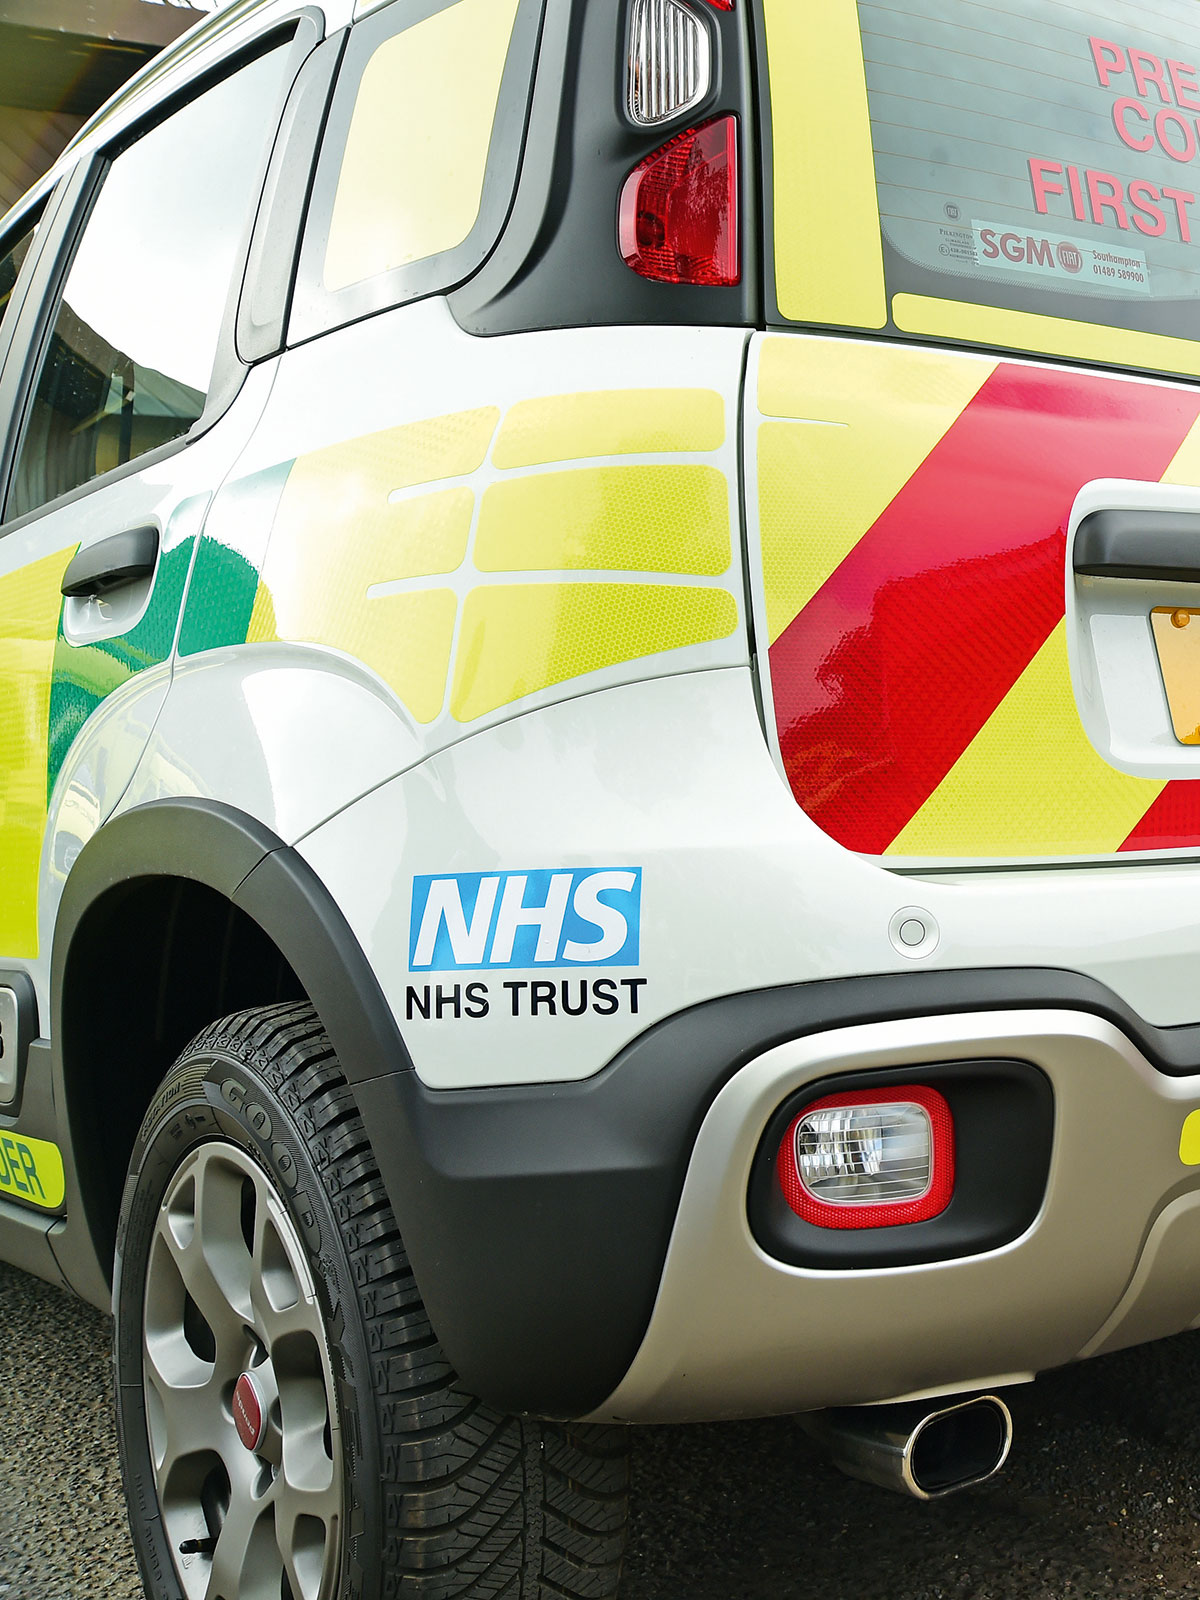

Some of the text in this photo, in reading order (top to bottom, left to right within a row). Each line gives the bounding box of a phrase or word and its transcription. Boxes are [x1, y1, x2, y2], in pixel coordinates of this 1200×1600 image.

[1028, 158, 1195, 243] FIRST
[980, 229, 1056, 269] SGM
[1061, 250, 1078, 266] FIAT
[1092, 249, 1141, 268] Southampton
[1093, 264, 1144, 283] 01489 589900
[412, 871, 637, 966] NHS
[406, 978, 647, 1020] NHS TRUST
